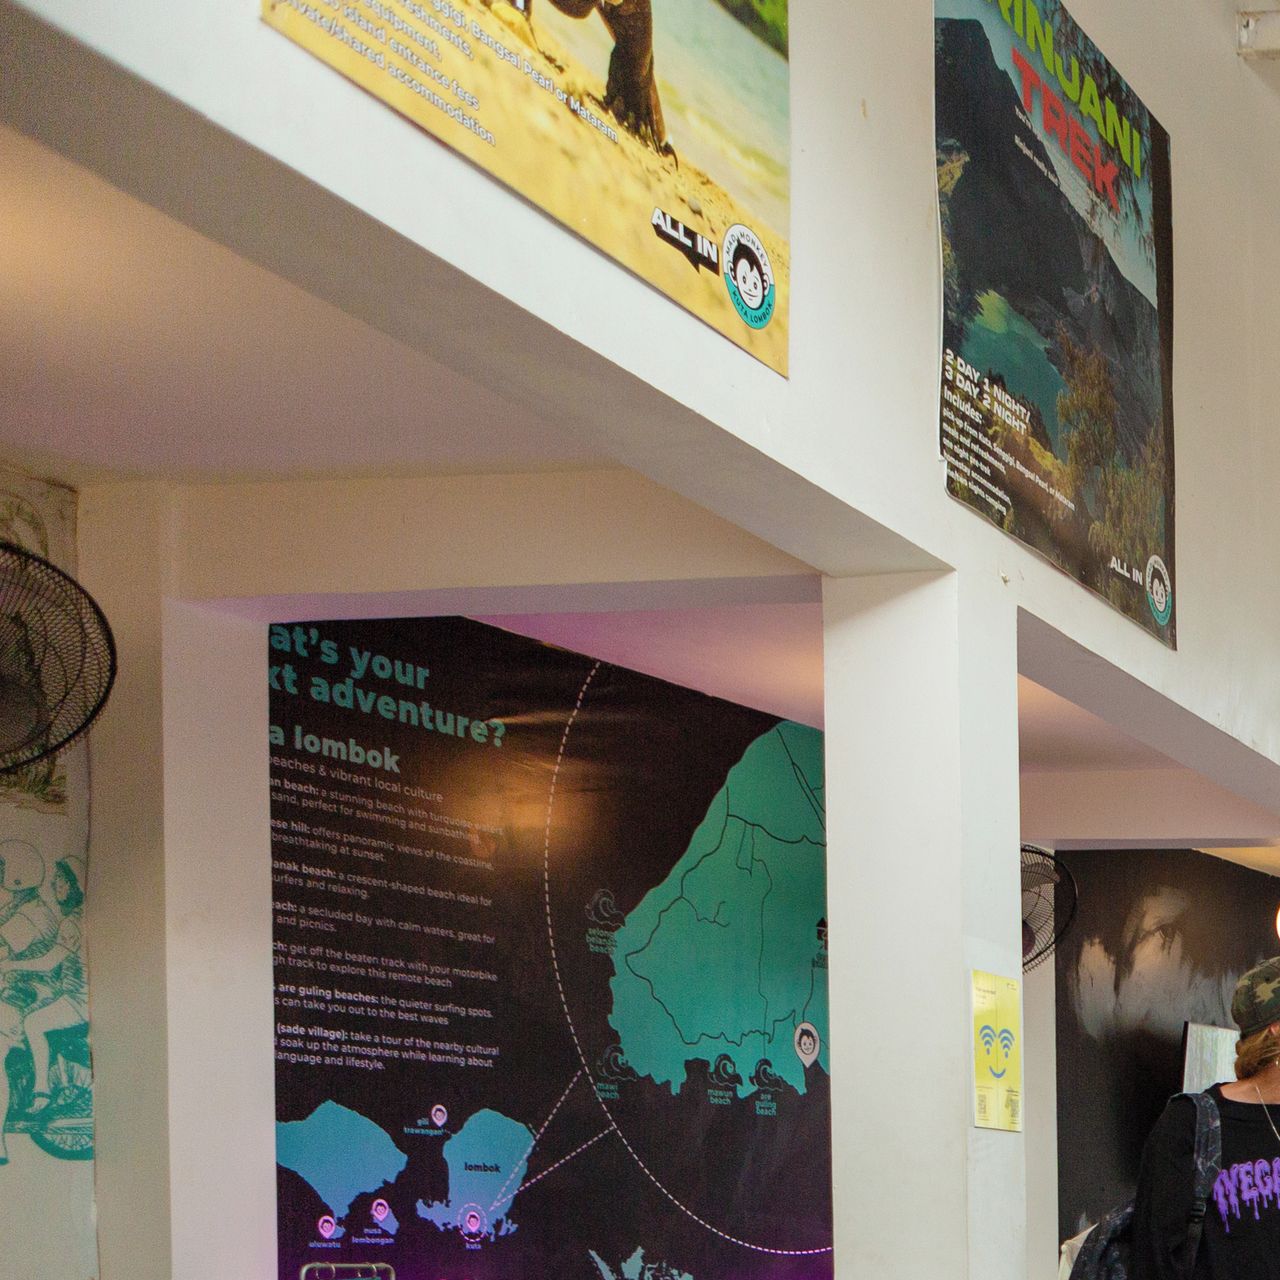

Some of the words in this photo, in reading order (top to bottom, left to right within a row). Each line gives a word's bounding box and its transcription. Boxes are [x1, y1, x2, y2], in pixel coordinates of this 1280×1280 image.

[343, 5, 387, 45] island
[388, 37, 451, 89] entrance
[450, 79, 480, 110] fees
[471, 22, 521, 69] Bangsal
[523, 61, 555, 94] Pearl
[555, 88, 568, 104] or
[569, 95, 619, 144] Mataram
[387, 62, 496, 146] accommodation
[1011, 47, 1121, 213] TREK
[651, 206, 693, 249] ALL
[696, 233, 718, 264] IN
[725, 233, 739, 256] MAD
[739, 231, 769, 267] MONKEY
[732, 290, 749, 319] KUTA
[750, 302, 774, 324] LOMBOK
[943, 386, 983, 425] Includes:
[945, 364, 954, 381] 3
[955, 373, 981, 400] DAY
[982, 394, 991, 410] 2
[993, 401, 1027, 436] NIGHT
[946, 348, 955, 366] 2
[956, 357, 981, 384] DAY
[983, 377, 991, 393] 1
[993, 384, 1031, 424] NIGHT/
[1110, 555, 1131, 578] ALL
[1132, 567, 1143, 586] IN
[270, 625, 339, 665] at's
[349, 646, 430, 690] your
[309, 675, 507, 749] adventure?
[294, 725, 401, 774] lombok
[284, 778, 320, 796] beach:
[329, 790, 374, 811] stunning
[376, 798, 406, 814] beach
[407, 806, 429, 820] with
[318, 764, 328, 777] &
[329, 767, 372, 789] vibrant
[374, 778, 402, 794] local
[403, 785, 445, 803] culture
[302, 797, 338, 814] perfect
[340, 804, 354, 816] for
[355, 809, 407, 830] swimming
[408, 819, 427, 832] and
[271, 832, 338, 856] breathtaking
[339, 845, 351, 857] at
[351, 849, 386, 864] sunset.
[290, 820, 311, 835] hill:
[312, 826, 343, 841] offers
[343, 831, 395, 852] panoramic
[396, 842, 424, 857] views
[425, 847, 435, 859] of
[435, 850, 452, 863] the
[301, 863, 337, 880] beach:
[346, 873, 426, 897] crescent-shaped
[427, 886, 457, 901] beach
[457, 892, 479, 905] ideal
[479, 894, 493, 907] for
[305, 878, 326, 892] and
[327, 882, 370, 901] relaxing.
[276, 913, 297, 926] and
[299, 917, 338, 933] picnics.
[307, 906, 353, 922] secluded
[355, 912, 374, 926] bay
[375, 915, 397, 929] with
[398, 920, 421, 933] calm
[456, 929, 481, 943] great
[481, 932, 496, 945] for
[287, 956, 316, 970] track
[316, 960, 328, 971] to
[329, 962, 367, 979] explore
[367, 966, 387, 980] this
[388, 971, 424, 985] remote
[424, 975, 453, 989] beach
[289, 944, 307, 957] get
[309, 945, 325, 957] off
[325, 948, 343, 960] the
[343, 950, 380, 965] beaten
[380, 955, 406, 969] track
[407, 960, 429, 973] with
[429, 965, 451, 977] your
[451, 966, 498, 983] motorbike
[278, 983, 297, 994] are
[298, 986, 332, 1001] guling
[334, 988, 379, 1005] beaches:
[380, 994, 398, 1007] the
[398, 997, 434, 1013] quieter
[434, 1001, 466, 1017] surfing
[467, 1006, 494, 1020] spots.
[280, 997, 302, 1008] can
[303, 999, 326, 1012] take
[327, 1003, 346, 1016] you
[348, 1005, 366, 1017] out
[367, 1007, 378, 1018] to
[379, 1007, 396, 1020] the
[397, 1010, 419, 1023] best
[420, 1015, 449, 1027] waves
[276, 1022, 306, 1036] (sade
[307, 1024, 349, 1042] village):
[350, 1031, 373, 1044] take
[381, 1034, 402, 1046] tour
[403, 1036, 414, 1047] of
[415, 1038, 432, 1050] the
[432, 1041, 465, 1056] nearby
[465, 1044, 500, 1057] cultural
[280, 1037, 304, 1050] soak
[306, 1040, 320, 1052] up
[321, 1040, 340, 1052] the
[340, 1042, 400, 1059] atmosphere
[400, 1048, 428, 1061] while
[428, 1050, 466, 1067] learning
[466, 1055, 494, 1068] about
[275, 1050, 322, 1066] language
[323, 1055, 344, 1067] and
[344, 1056, 386, 1071] lifestyle.
[464, 1161, 502, 1174] lombok
